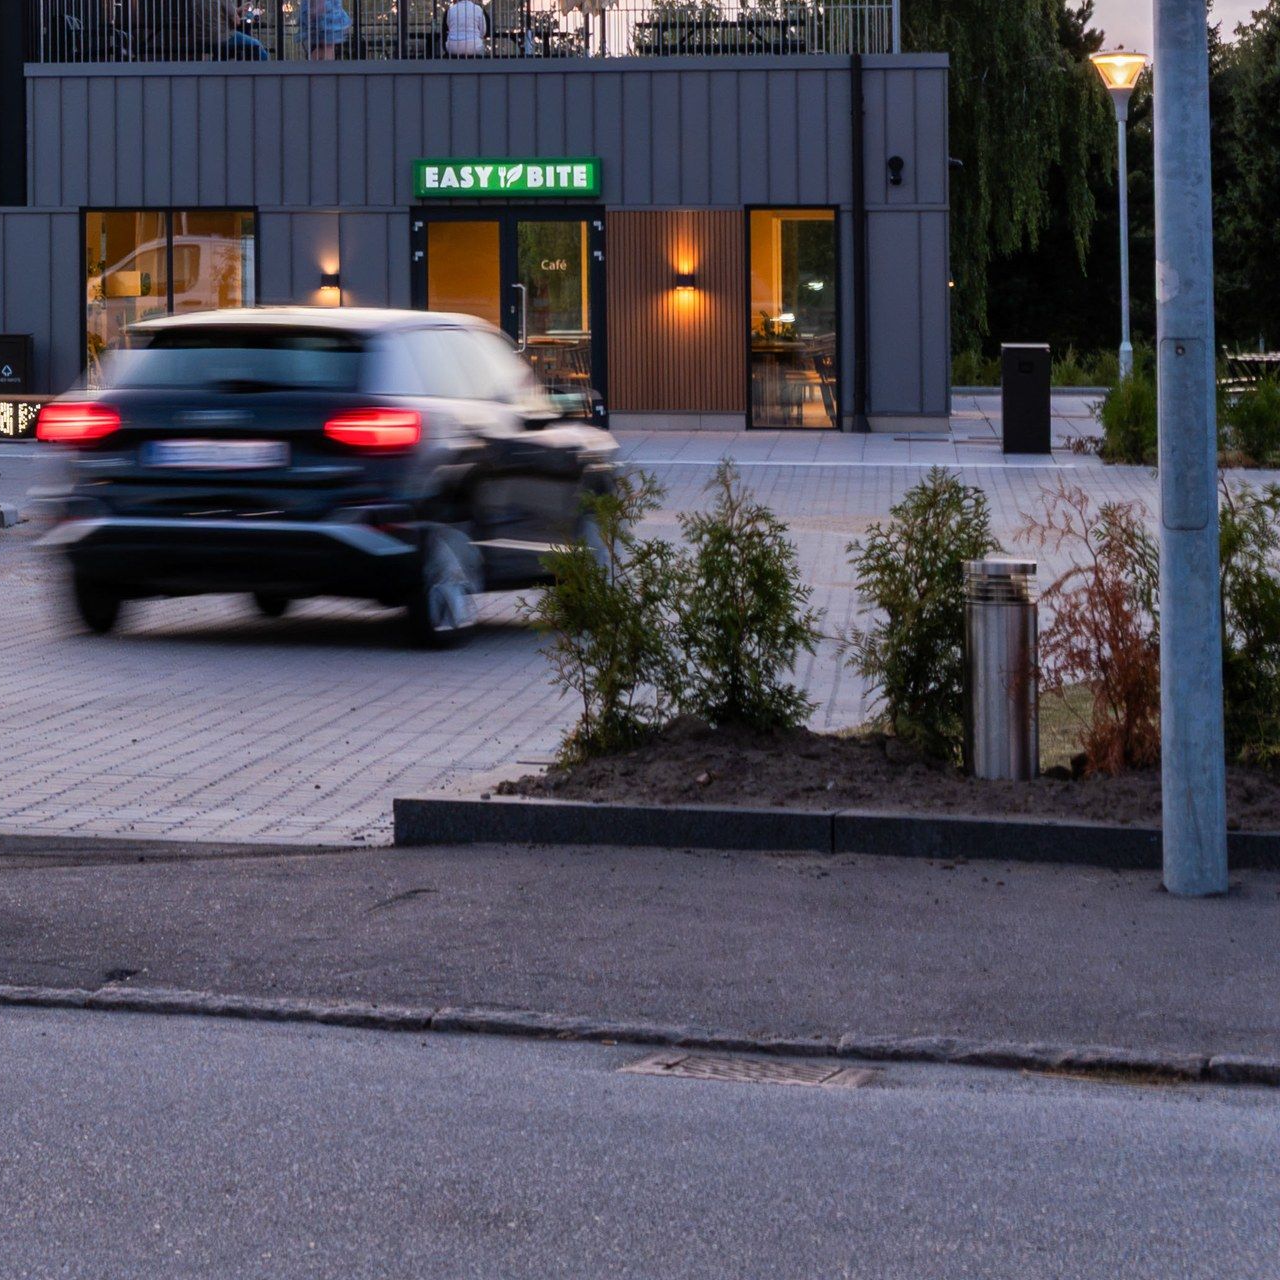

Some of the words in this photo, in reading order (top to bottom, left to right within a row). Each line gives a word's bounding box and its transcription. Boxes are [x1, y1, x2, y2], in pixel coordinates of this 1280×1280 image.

[425, 166, 494, 189] EASY
[526, 165, 588, 188] BITE
[541, 258, 568, 271] Café
